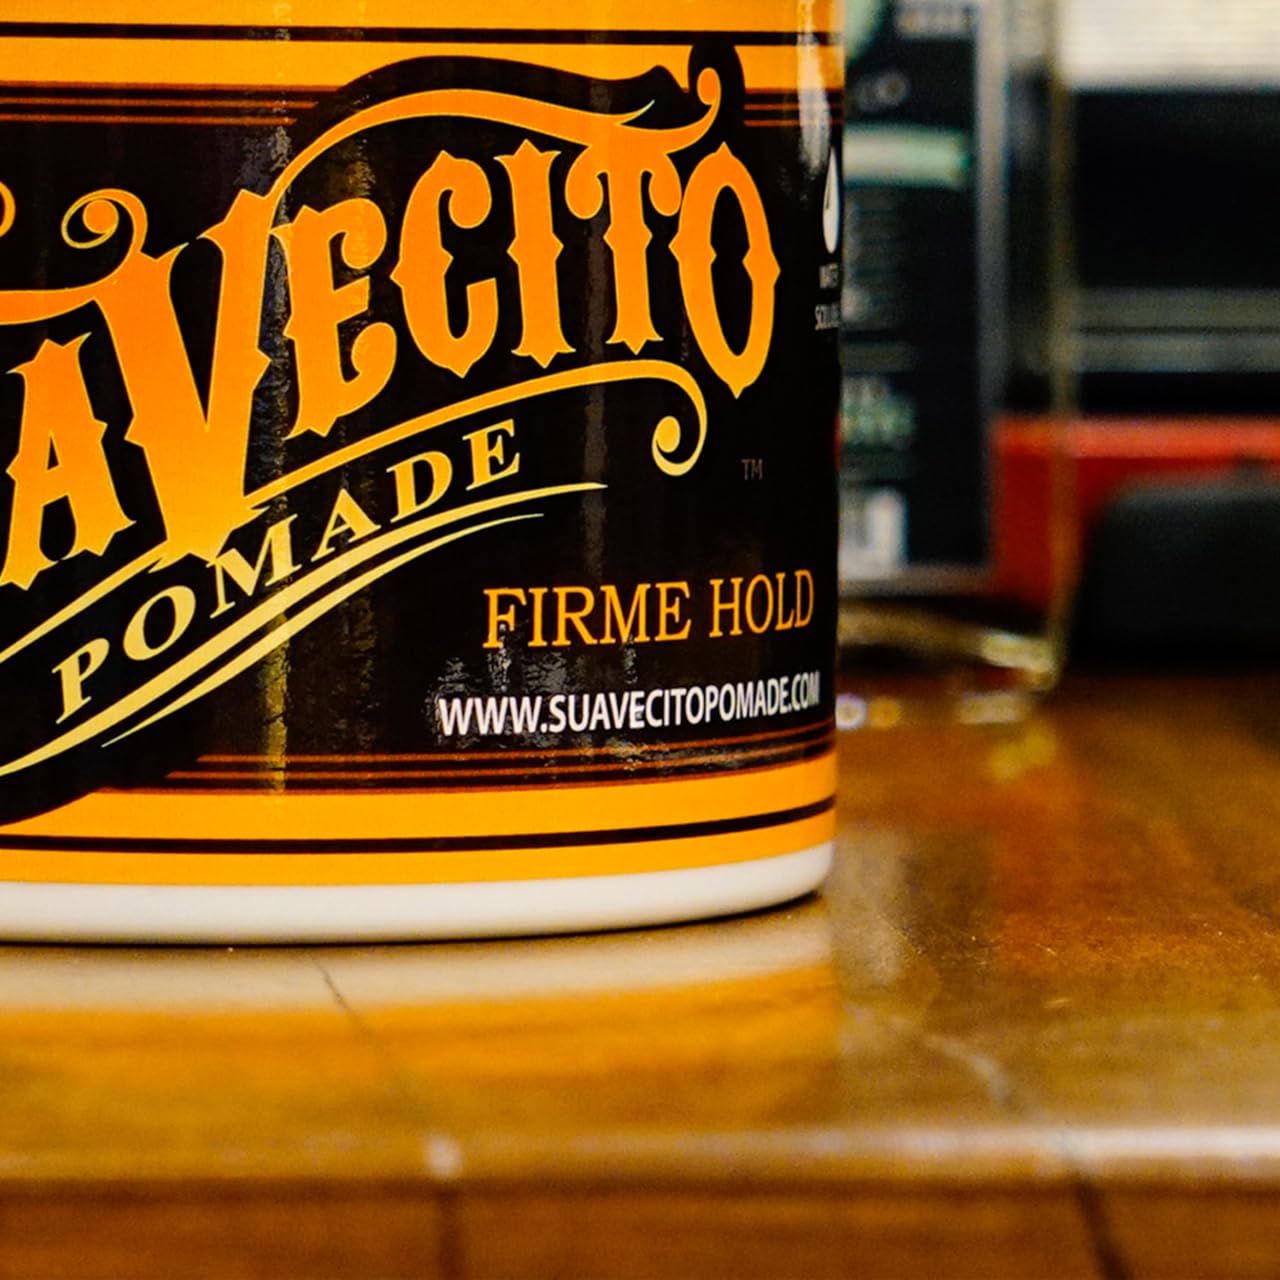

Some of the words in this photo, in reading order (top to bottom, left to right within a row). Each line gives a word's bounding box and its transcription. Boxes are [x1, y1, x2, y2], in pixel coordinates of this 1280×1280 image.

[741, 458, 763, 480] TM
[51, 418, 521, 725] POMADE
[482, 581, 692, 649] FIRME
[709, 569, 815, 638] HOLD
[438, 670, 821, 736] WWW.SUAVECITOPOMADE.COM
